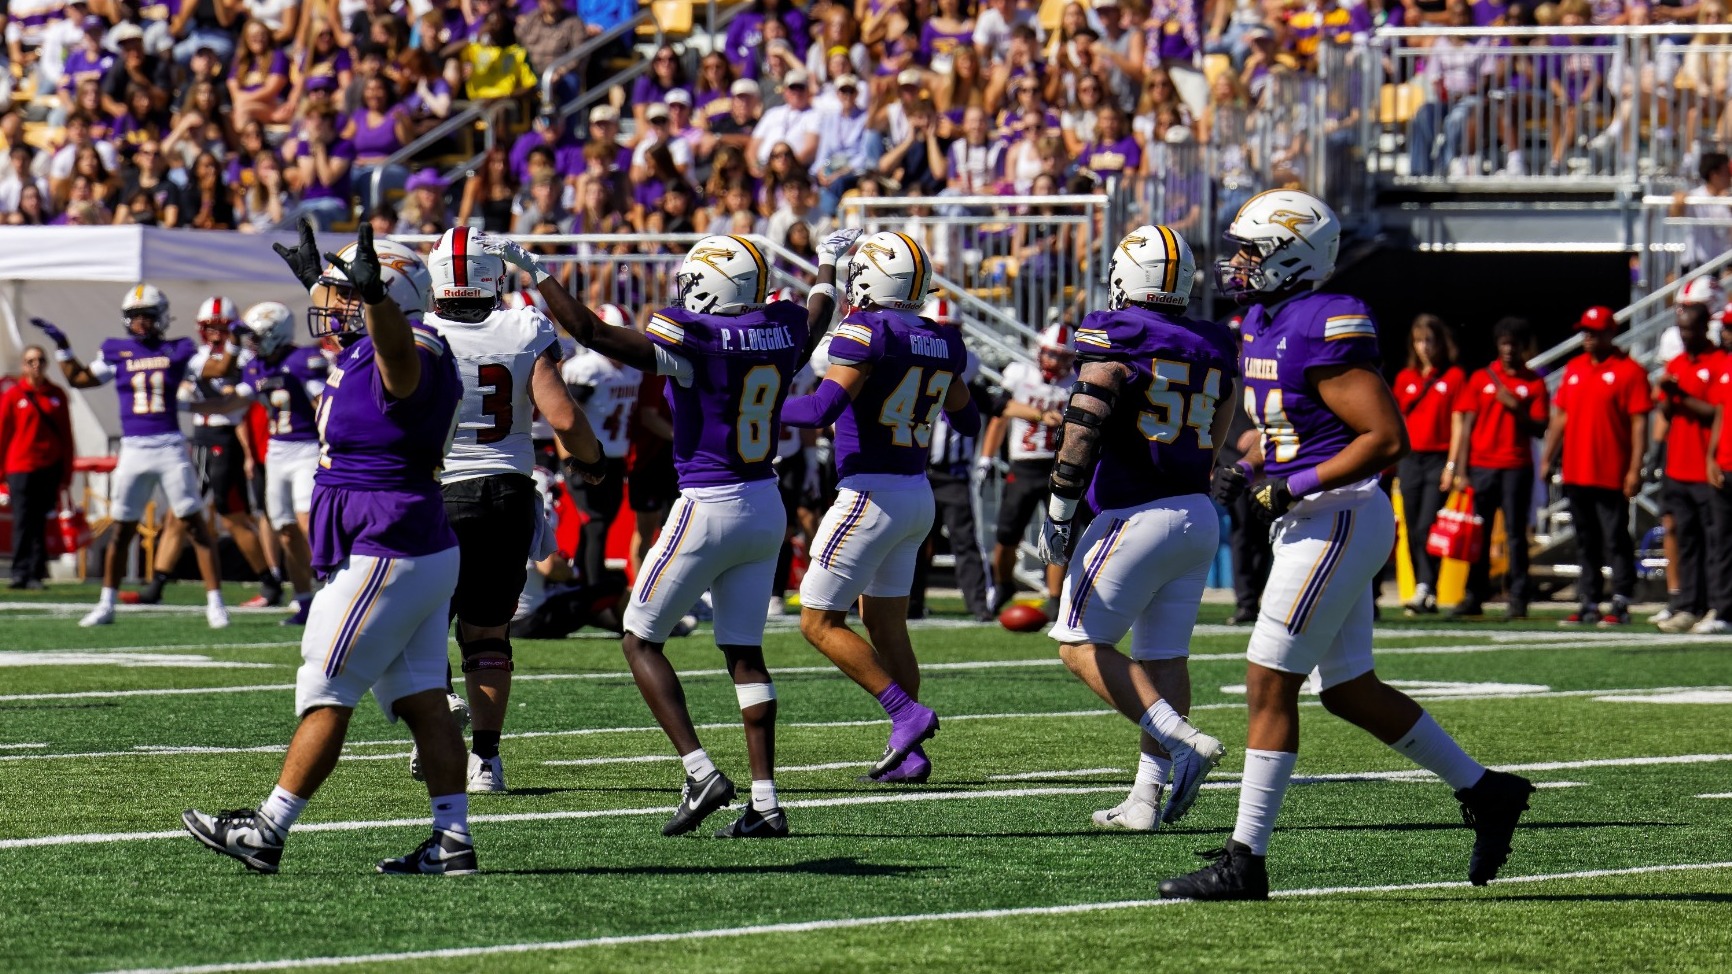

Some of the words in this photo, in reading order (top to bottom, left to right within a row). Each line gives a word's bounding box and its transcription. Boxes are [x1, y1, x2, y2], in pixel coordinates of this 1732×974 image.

[444, 289, 481, 298] Riddell
[1146, 293, 1185, 305] Riddell
[739, 325, 795, 351] LOGGALE
[909, 334, 950, 360] GAGNON
[130, 371, 166, 414] 11
[878, 366, 954, 449] 43
[1136, 357, 1222, 449] 54
[737, 364, 782, 464] 8
